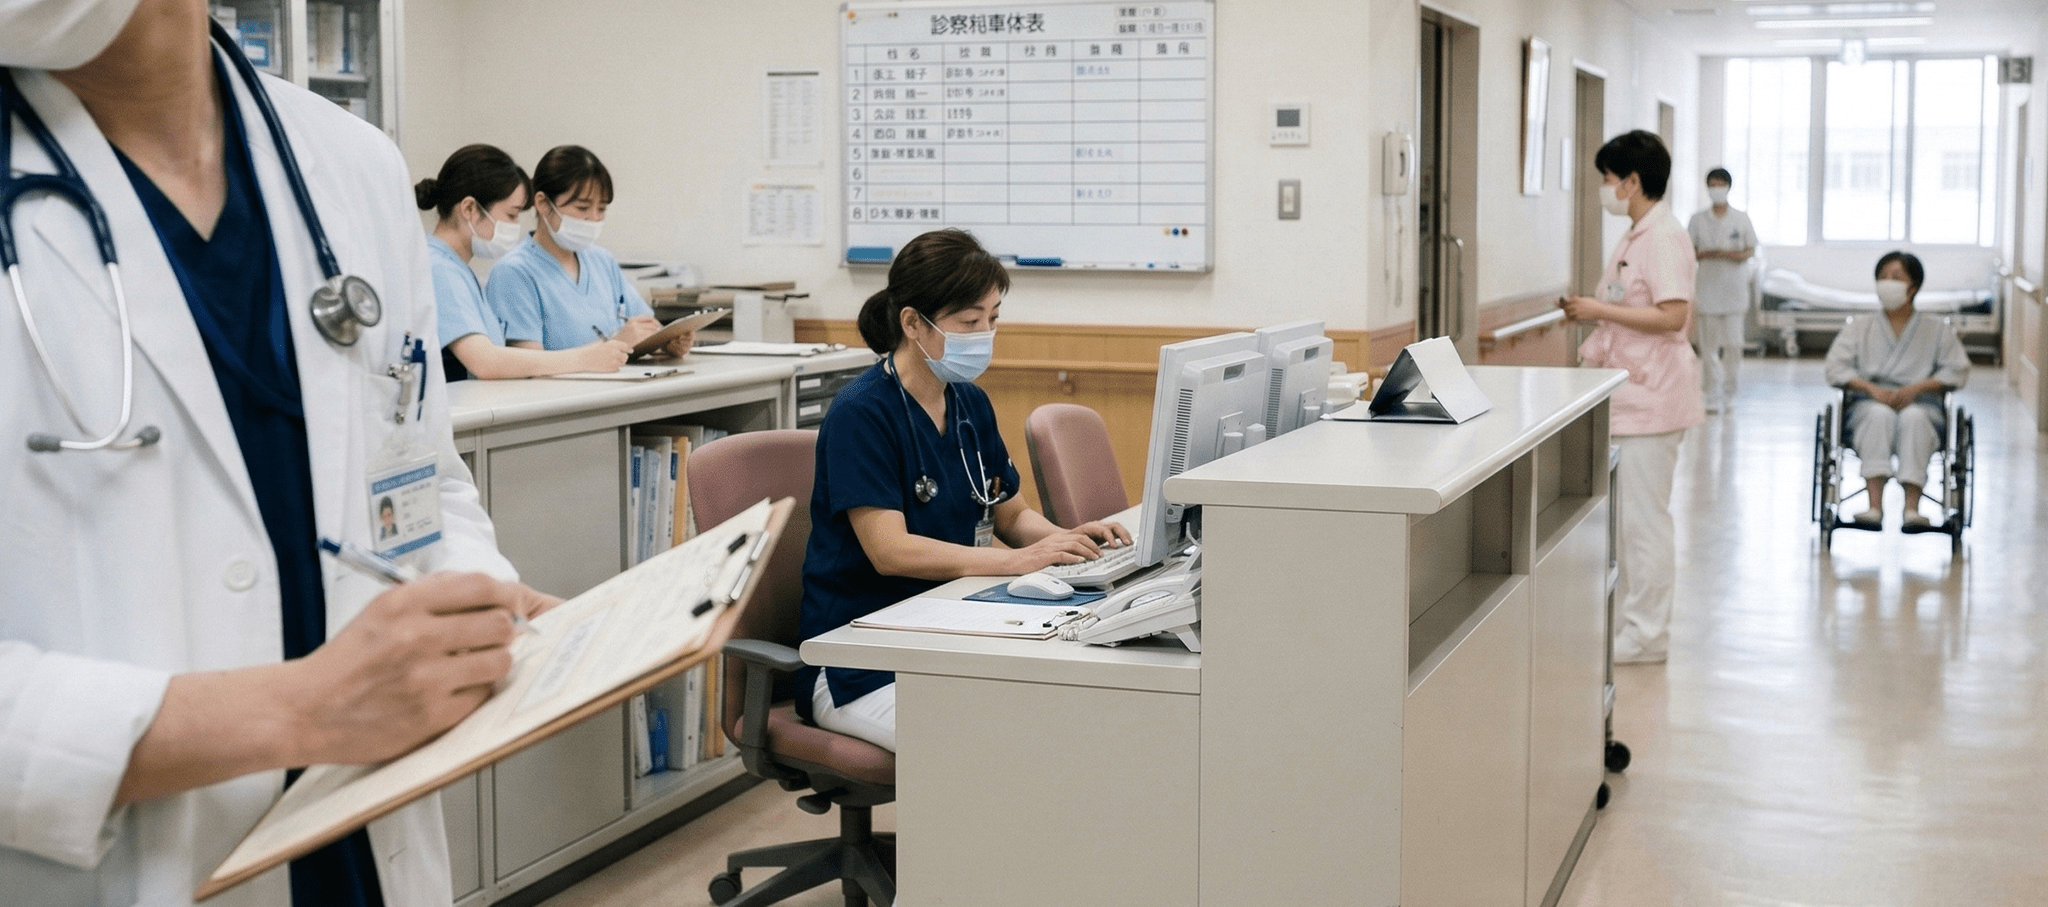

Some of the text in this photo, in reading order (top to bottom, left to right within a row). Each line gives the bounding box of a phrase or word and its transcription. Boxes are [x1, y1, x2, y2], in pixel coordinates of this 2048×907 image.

[853, 69, 859, 81] 1
[852, 88, 860, 101] 2
[852, 108, 861, 121] 3
[852, 128, 861, 140] 4
[853, 147, 861, 160] 5
[852, 167, 861, 180] 6
[853, 186, 861, 199] 7
[852, 206, 861, 220] 8
